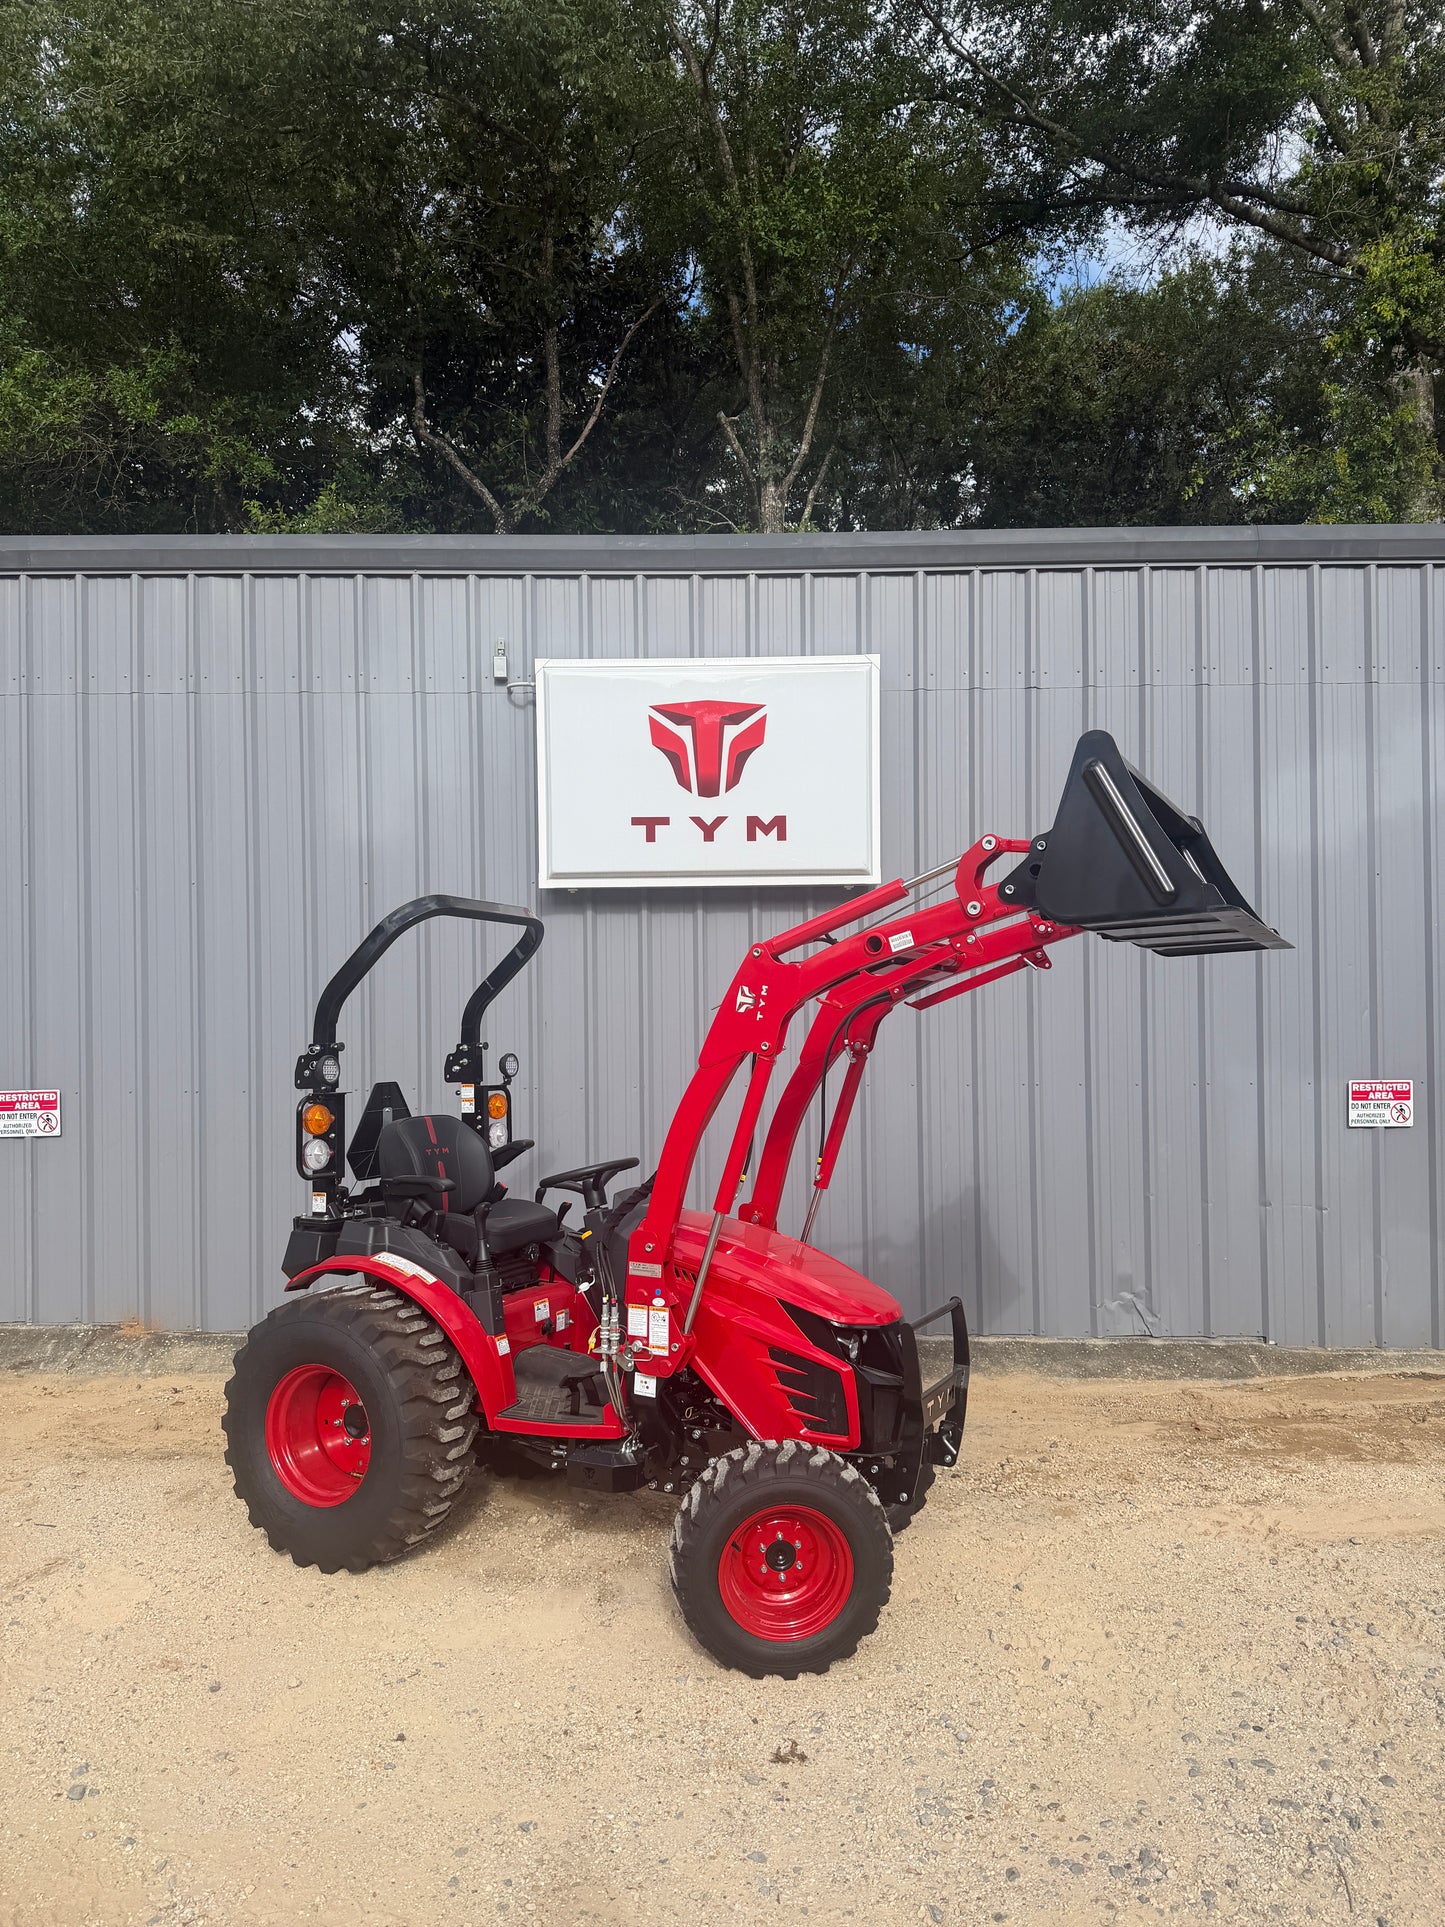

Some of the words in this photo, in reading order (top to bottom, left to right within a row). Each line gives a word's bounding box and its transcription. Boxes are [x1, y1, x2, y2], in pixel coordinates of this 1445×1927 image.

[631, 815, 787, 843] TYM
[756, 984, 769, 1021] TYM
[1352, 1083, 1409, 1091] RESTRICTED
[0, 1093, 56, 1102] RESTRICTED
[15, 1102, 40, 1110] AREA
[425, 1147, 449, 1156] TYM
